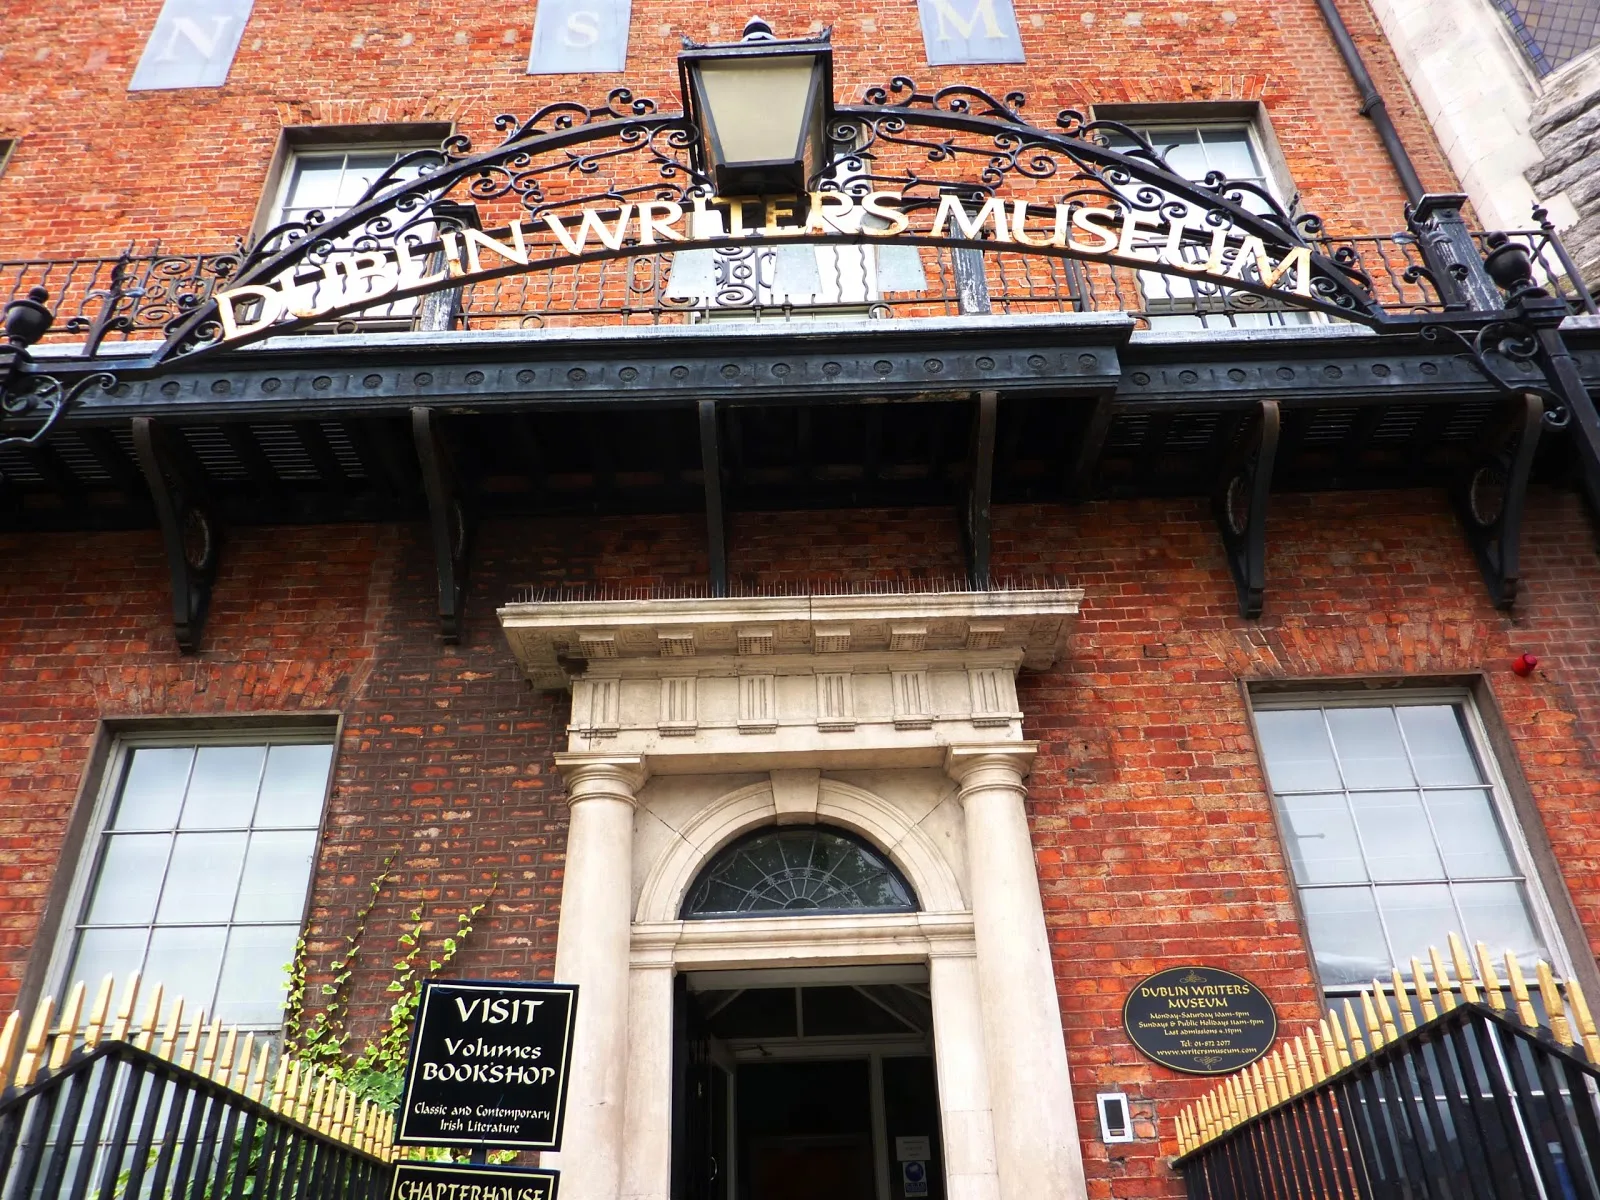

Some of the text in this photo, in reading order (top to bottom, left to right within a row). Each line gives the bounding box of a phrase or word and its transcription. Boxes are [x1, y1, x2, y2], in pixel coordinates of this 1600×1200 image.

[563, 10, 600, 48] S
[213, 190, 1313, 342] DUBLIN WRITERS MUSEUM
[1141, 984, 1250, 998] DUBLIN WRITERS
[455, 996, 545, 1025] VISIT
[1168, 997, 1228, 1009] MUSEUM
[1138, 1021, 1169, 1029] Sundays
[1199, 1019, 1229, 1028] Holidays
[1149, 1011, 1214, 1020] Monday-Saturday
[444, 1037, 542, 1060] Volumes
[1156, 1048, 1257, 1056] www.writersmuseum.com
[422, 1062, 556, 1085] BOOKSHOP
[414, 1102, 551, 1121] Classic and Contemporary
[440, 1119, 520, 1134] Irish Literature
